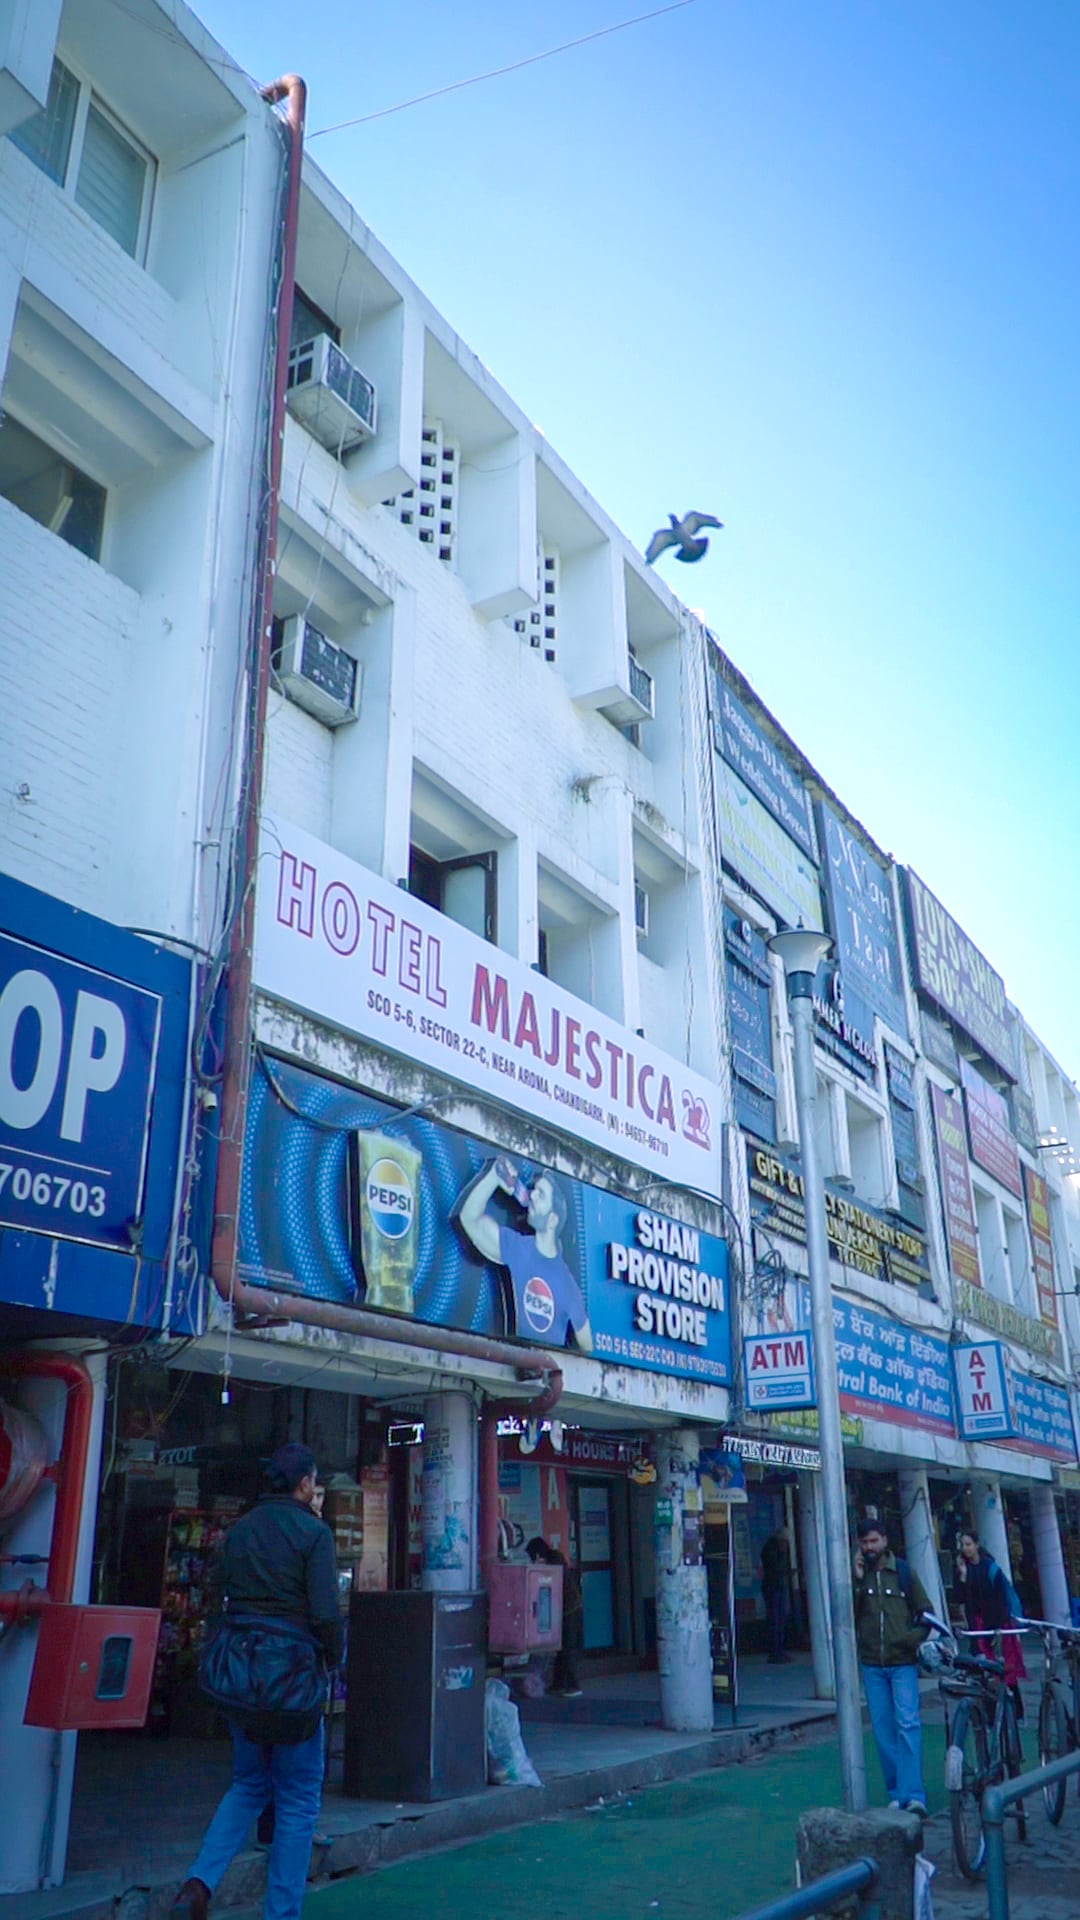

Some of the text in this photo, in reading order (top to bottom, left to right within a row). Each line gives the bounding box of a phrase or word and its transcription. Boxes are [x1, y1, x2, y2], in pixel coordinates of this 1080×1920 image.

[909, 872, 961, 971] TOYS
[277, 851, 446, 1008] HOTEL
[471, 963, 676, 1132] MAJESTICA
[0, 969, 126, 1143] OP
[367, 990, 390, 1016] SCO
[420, 1015, 460, 1051] SECTOR
[491, 1055, 516, 1080] NEAR
[0, 1163, 106, 1217] 706703
[369, 1184, 412, 1211] PEPSI
[755, 1152, 784, 1187] GIFT
[787, 1169, 798, 1195] &
[638, 1211, 700, 1265] SHAM
[838, 1197, 896, 1247] STATIONERY
[610, 1242, 724, 1312] PROVISION
[526, 1294, 552, 1316] PEPSI
[636, 1292, 708, 1346] STORE
[752, 1341, 805, 1370] ATM
[858, 1339, 882, 1368] बैंक
[868, 1376, 903, 1404] Bank
[905, 1387, 921, 1407] of
[922, 1388, 951, 1416] India
[969, 1350, 992, 1412] ATM
[573, 1442, 615, 1461] HOURS
